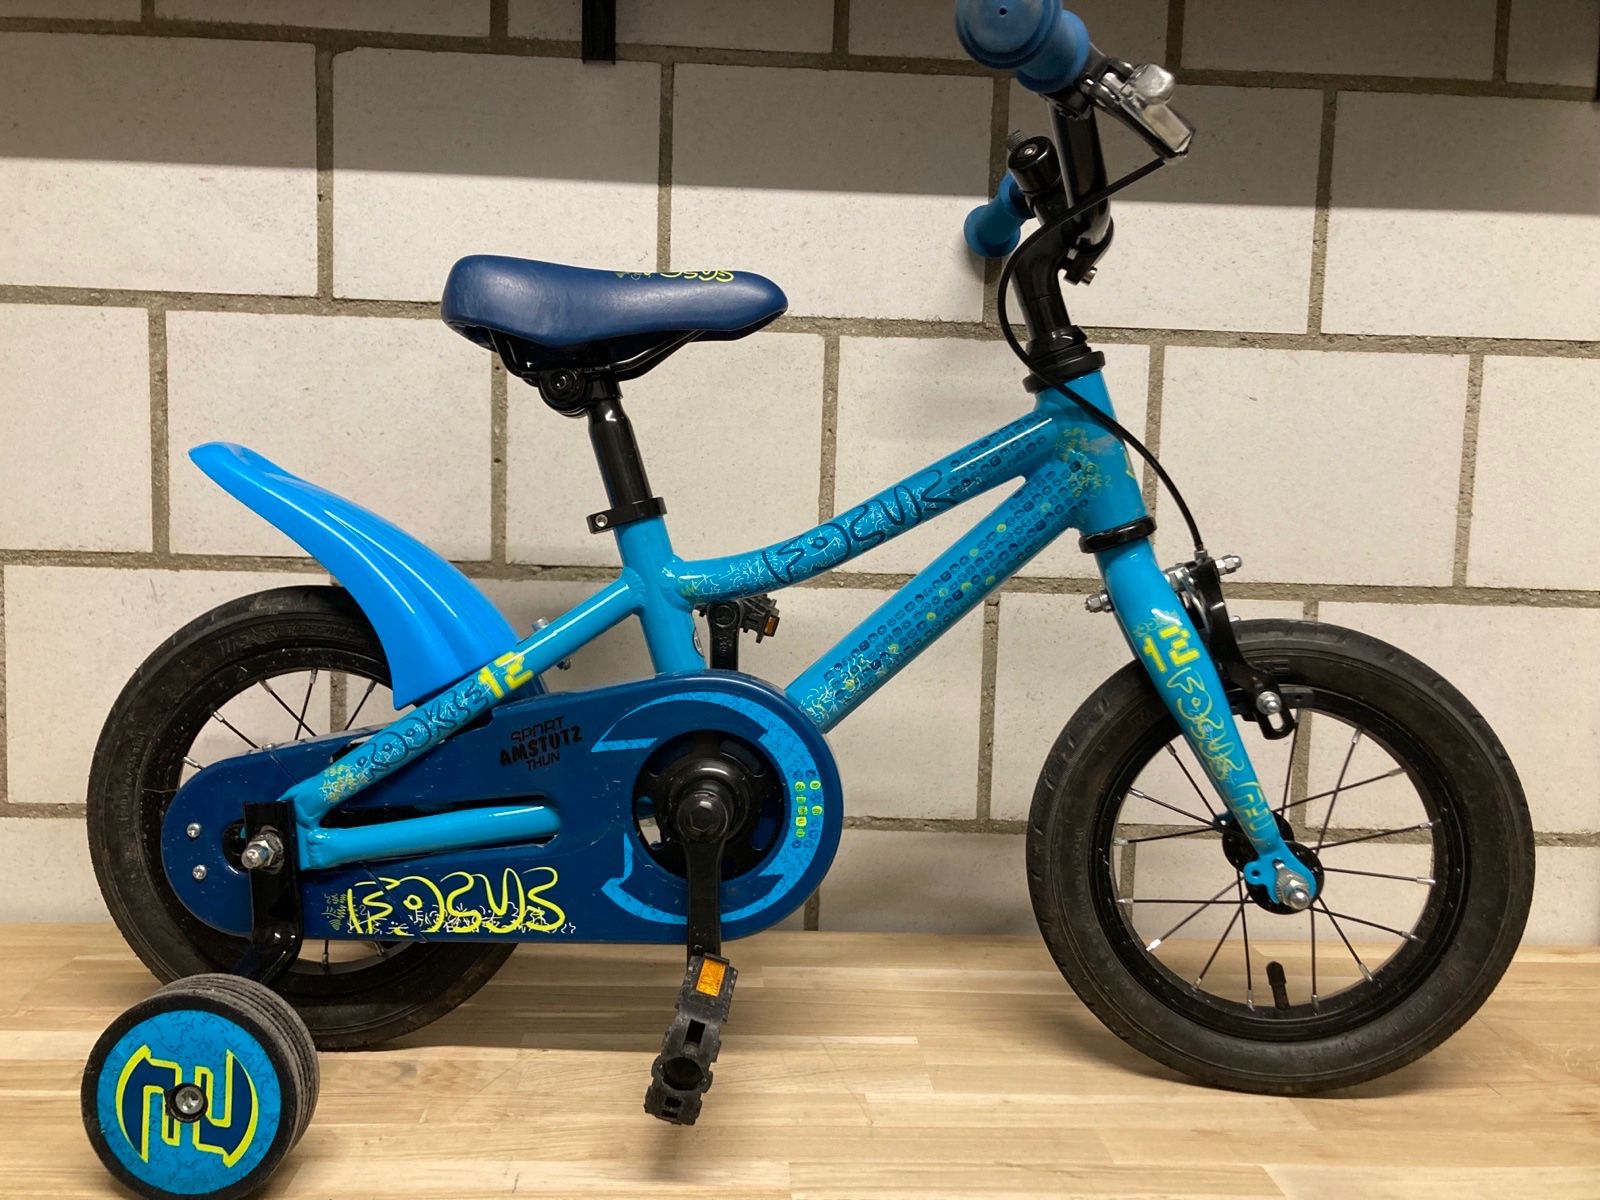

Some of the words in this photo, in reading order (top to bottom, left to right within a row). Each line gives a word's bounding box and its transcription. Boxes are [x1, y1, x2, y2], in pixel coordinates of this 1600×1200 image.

[1142, 625, 1200, 673] 12
[478, 651, 534, 699] 12
[500, 725, 583, 766] AMSTUTZ
[511, 716, 566, 742] SPORT
[526, 751, 561, 771] THUN
